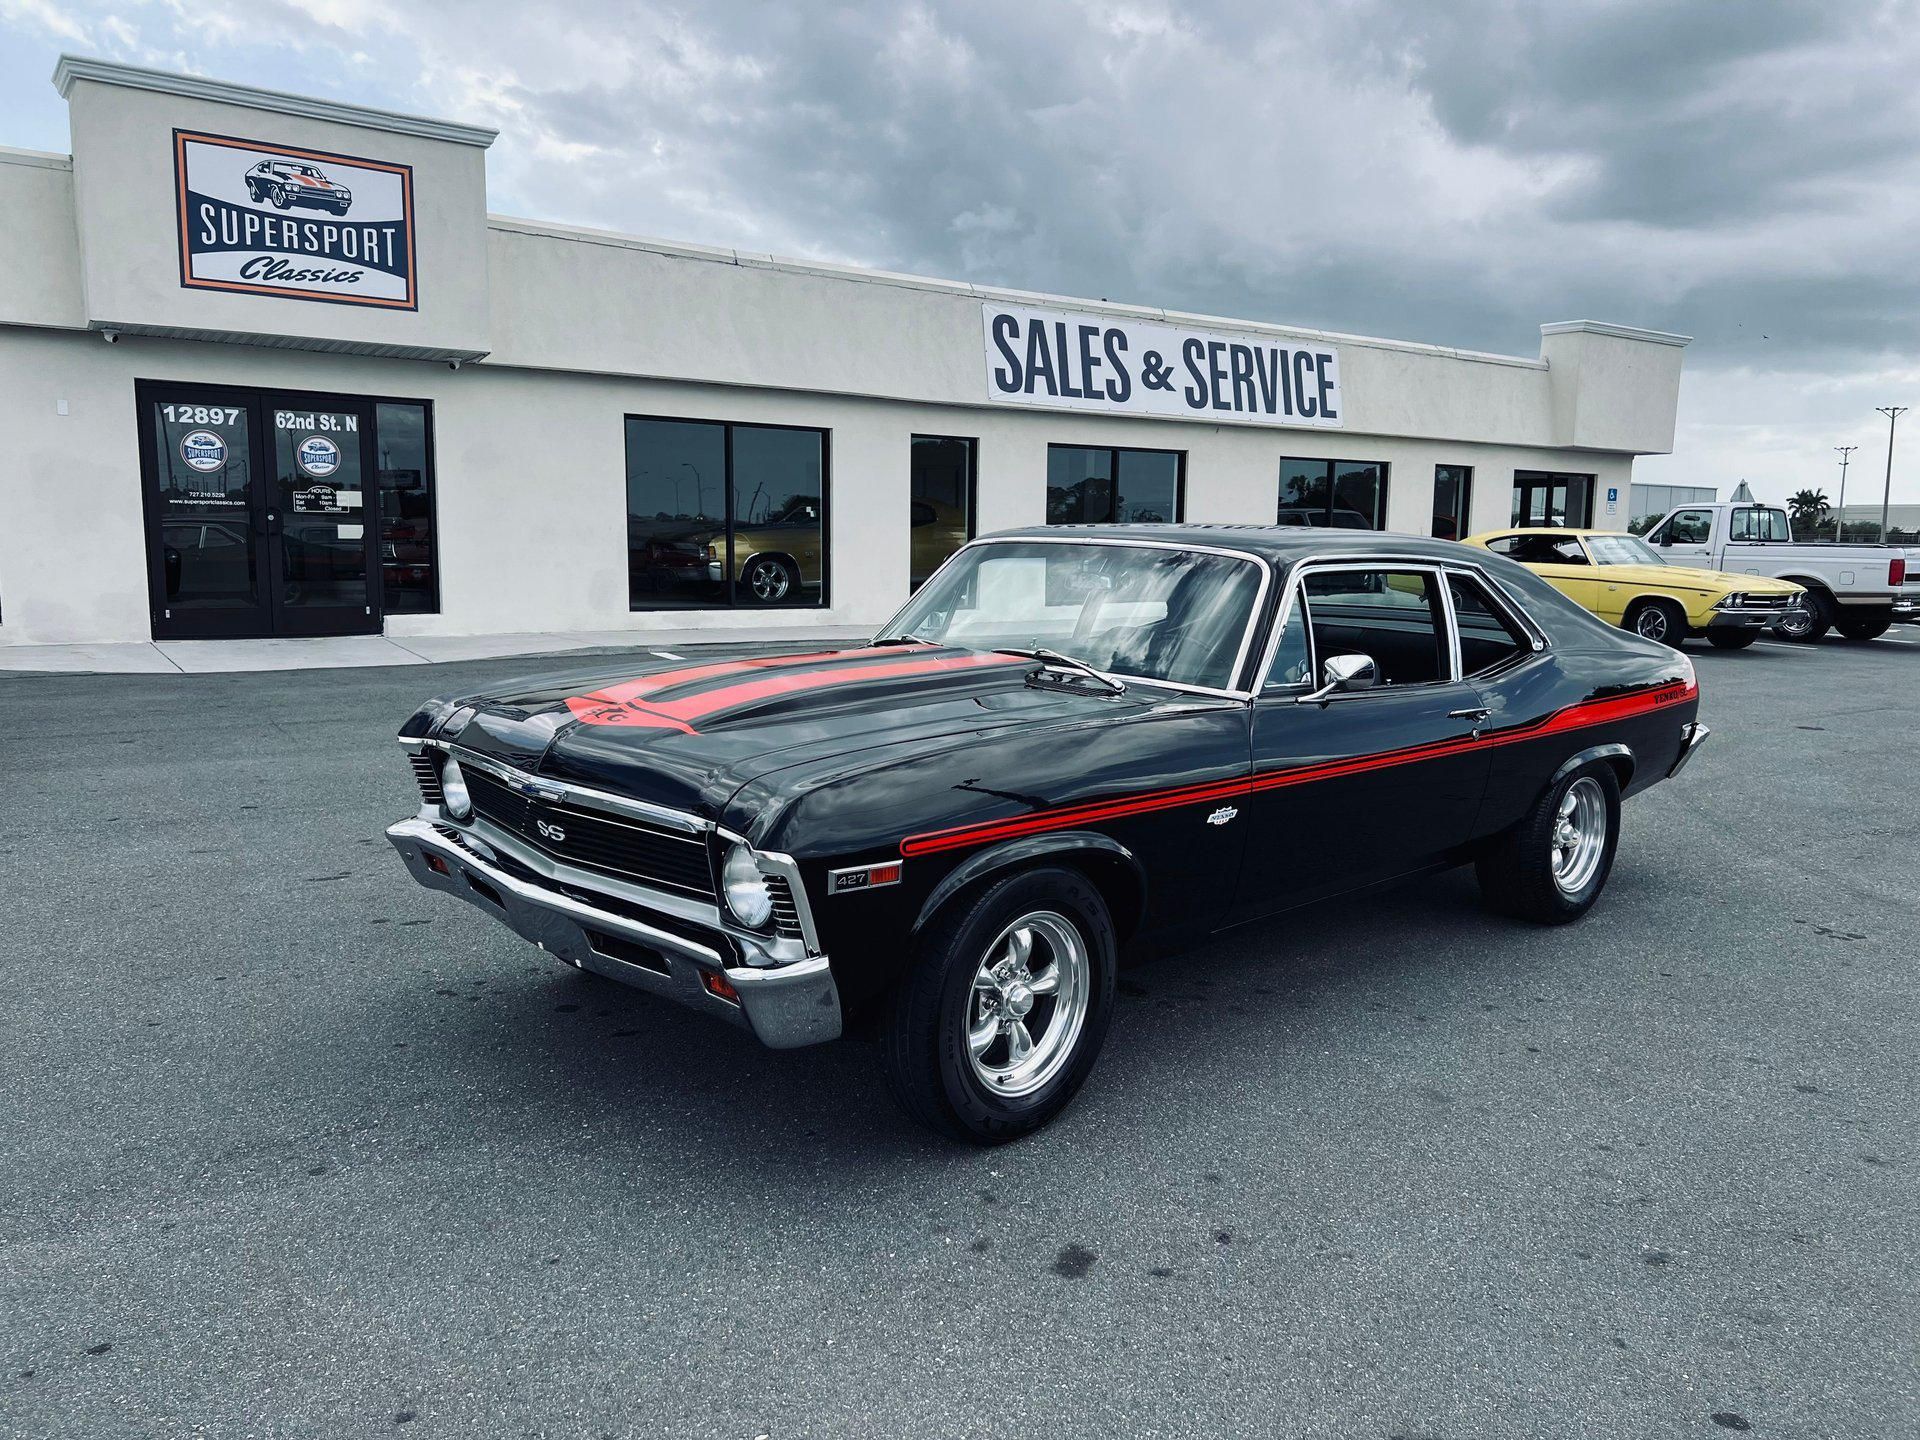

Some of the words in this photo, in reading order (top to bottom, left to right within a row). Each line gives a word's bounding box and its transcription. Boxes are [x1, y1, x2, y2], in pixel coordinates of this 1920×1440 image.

[201, 203, 395, 267] SUPERSPORT
[239, 255, 364, 284] Classics
[992, 314, 1132, 403] SALES
[1141, 350, 1177, 392] &
[1182, 337, 1337, 419] SERVICE
[163, 405, 239, 426] 12897
[276, 412, 315, 430] 62nd
[320, 414, 341, 431] St.
[345, 415, 357, 432] N
[188, 447, 221, 459] SUPERSPORT
[304, 452, 335, 464] SUPERSPORT
[537, 820, 566, 841] SS
[837, 873, 866, 886] 427
